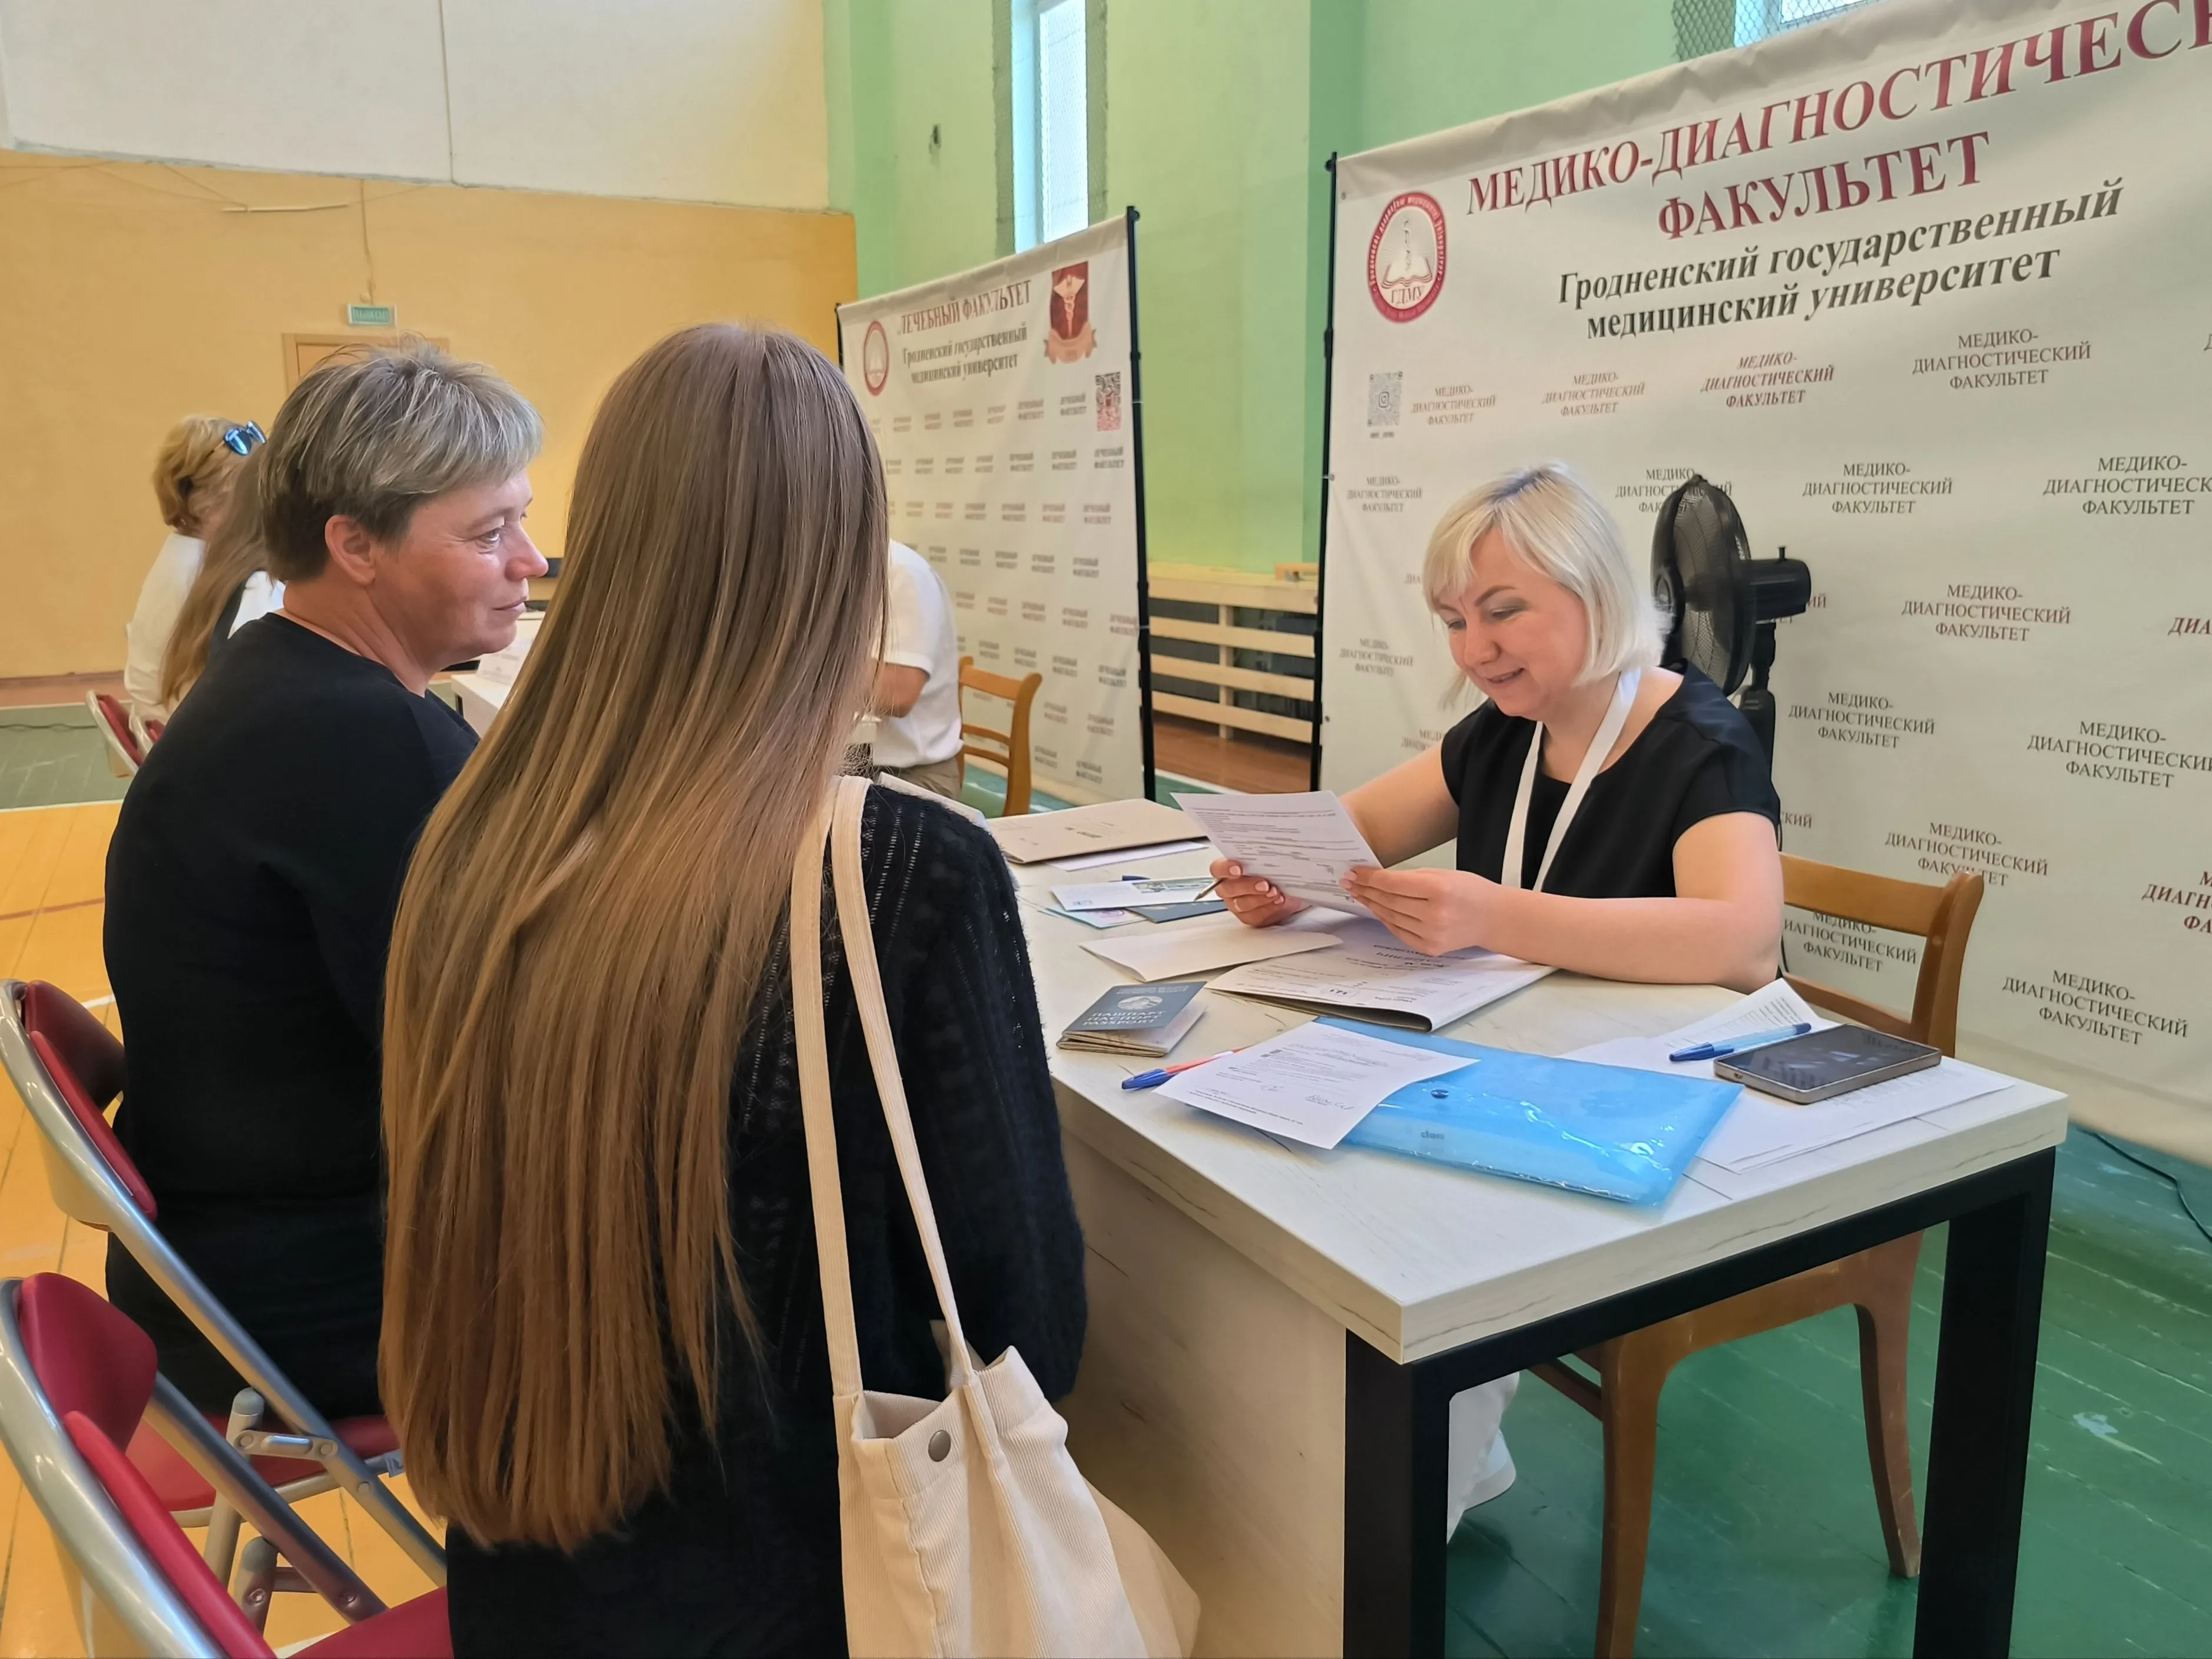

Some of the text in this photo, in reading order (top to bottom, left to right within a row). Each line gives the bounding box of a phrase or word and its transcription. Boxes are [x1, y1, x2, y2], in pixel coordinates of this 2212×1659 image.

[1658, 131, 1989, 240] ФАКУЛЬТЕТ
[1559, 177, 2124, 310] Гродненский государственный
[1587, 249, 2060, 339] медицинский университет
[898, 280, 1031, 335] ЛЕЧЕБНЫЙ ФАКУЛЬТЕТ
[1959, 329, 2038, 349] МЕДИКО-
[1737, 352, 1797, 369] МЕДИКО-
[1912, 341, 2091, 375] ДИАГНОСТИЧЕСКИЙ
[1574, 372, 1618, 385] МЕДИКО-
[1700, 365, 1834, 392] ДИАГНОСТИЧЕСКИЙ
[1950, 369, 2049, 389] ФАКУЛЬТЕТ
[1542, 382, 1645, 403] ДИАГНОСТИЧЕСКИЙ
[1726, 390, 1806, 408] ФАКУЛЬТЕТ
[1561, 402, 1618, 416] ФАКУЛЬТЕТ
[1646, 468, 1695, 481] МЕДИКО
[1844, 463, 1910, 478] МЕДИКО-
[2098, 455, 2187, 473] МЕДИКО-
[1802, 478, 1952, 496] ДИАГНОСТИЧЕСКИЙ
[1832, 501, 1916, 514] ФАКУЛЬТЕТ
[2082, 499, 2195, 514] ФАКУЛЬТЕТ
[1947, 584, 2022, 601] МЕДИКО-
[1902, 601, 2070, 624] ДИАГНОСТИЧЕСКИЙ
[1936, 622, 2029, 641] ФАКУЛЬТЕТ
[1829, 692, 1893, 710] МЕДИКО-
[1788, 706, 1934, 734] ДИАГНОСТИЧЕСКИЙ
[1818, 726, 1899, 749] ФАКУЛЬТЕТ
[2080, 721, 2166, 743] МЕДИКО-
[2066, 761, 2174, 787] ФАКУЛЬТЕТ
[1930, 822, 2002, 846] МЕДИКО-
[1885, 833, 2048, 876] ДИАГНОСТИЧЕСКИЙ
[1784, 919, 1916, 964] ИАГНОСТИЧЕСКИЙ
[1804, 942, 1883, 972] ФАКУЛЬТЕТ
[2053, 970, 2135, 1000] МЕДИКО-
[2002, 977, 2187, 1037] ДИАГНОСТИЧЕСКИЙ
[2039, 1007, 2142, 1045] ФАКУЛЬТЕТ
